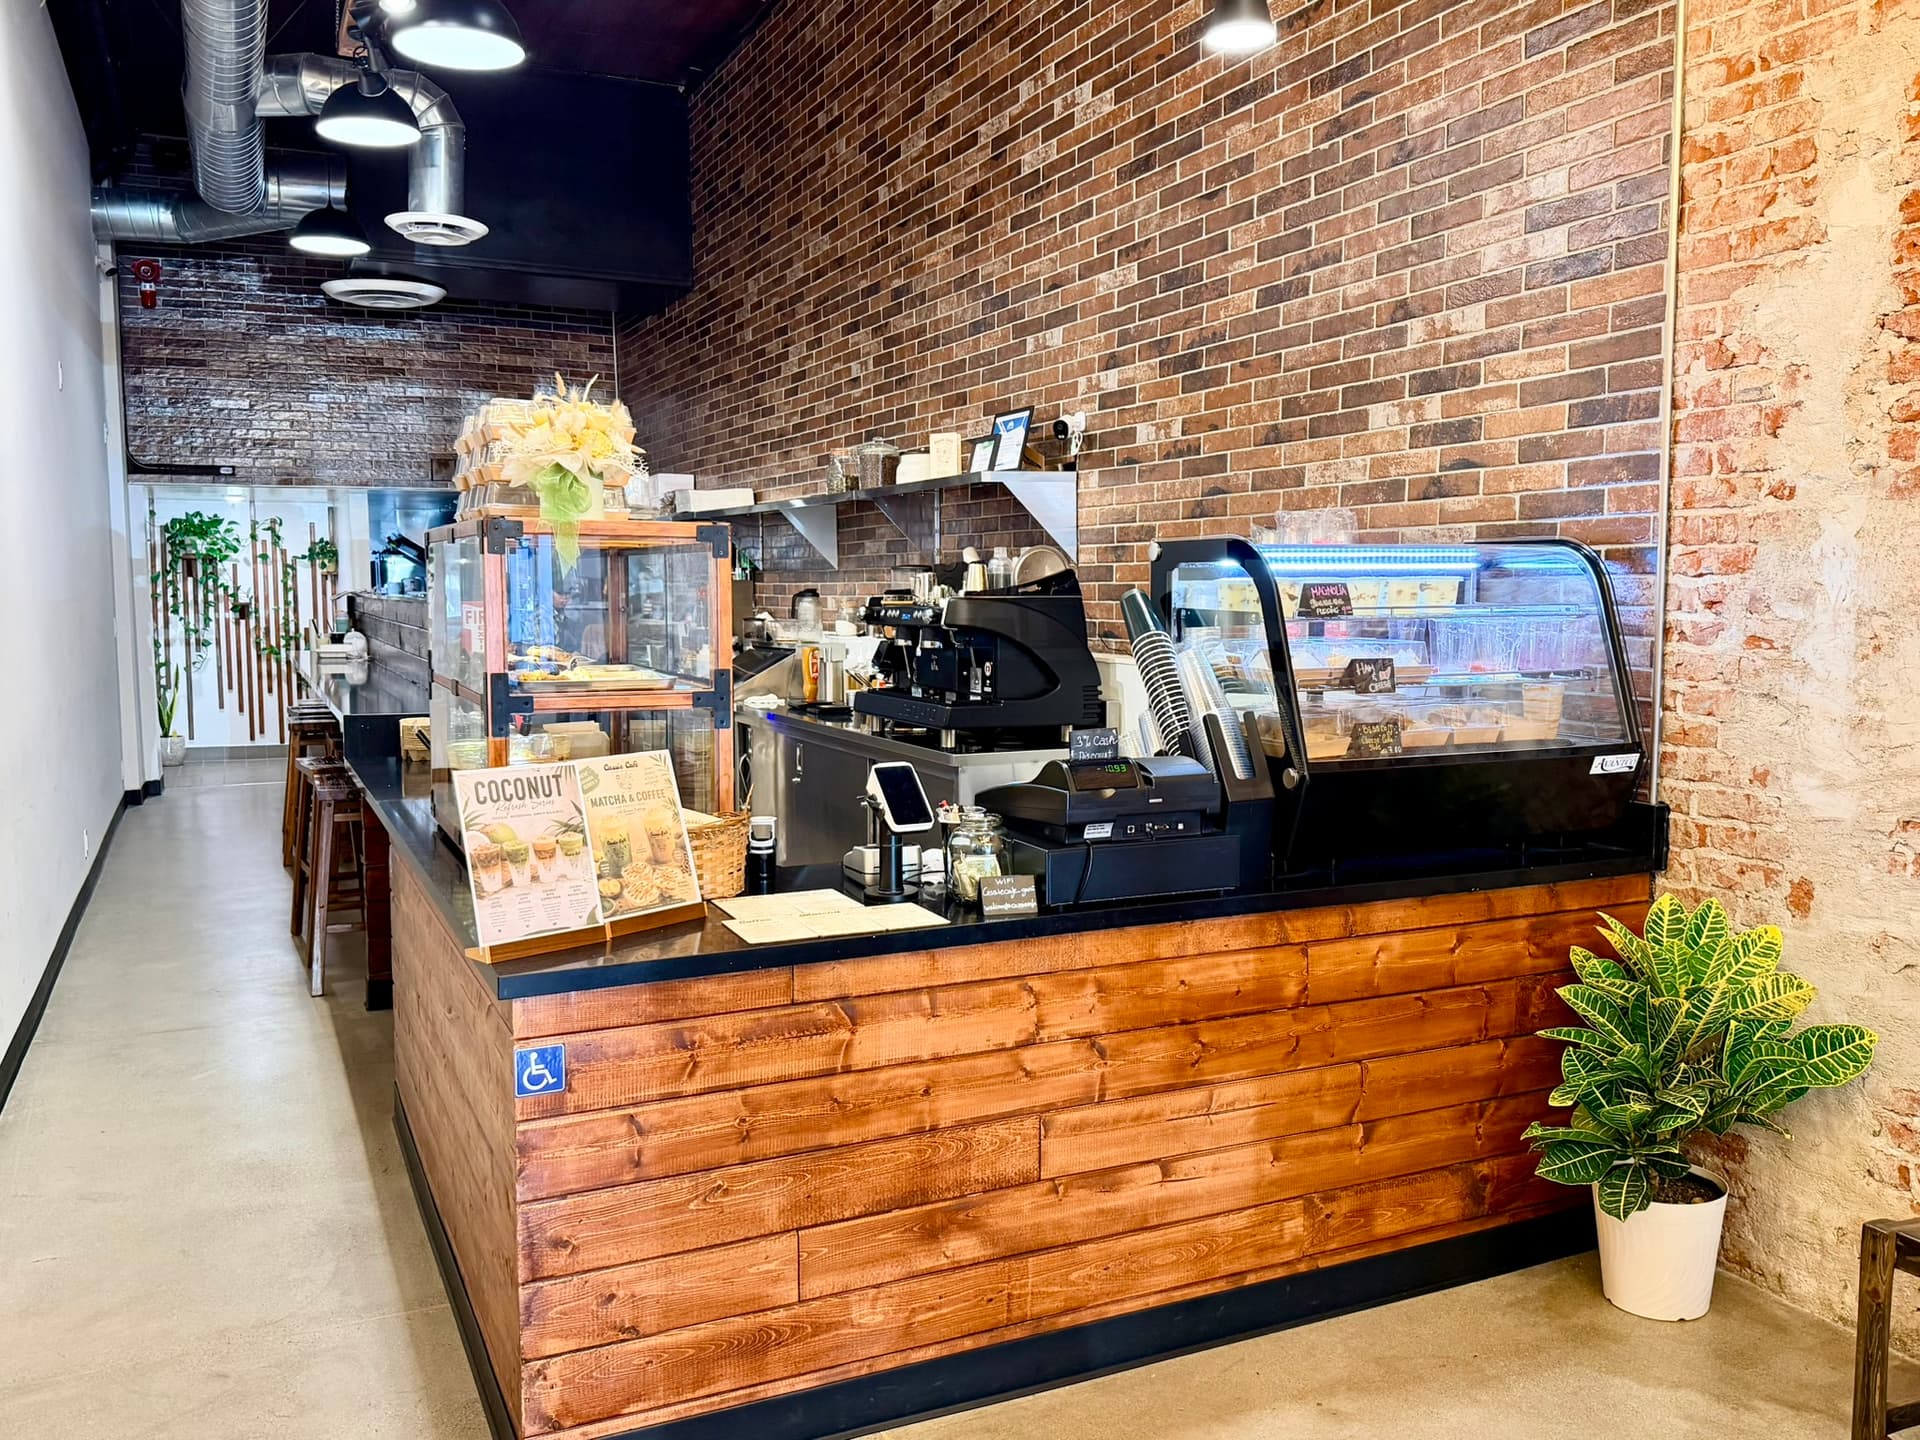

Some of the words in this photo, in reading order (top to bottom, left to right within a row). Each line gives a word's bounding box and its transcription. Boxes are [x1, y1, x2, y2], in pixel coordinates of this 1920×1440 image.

[1311, 585, 1347, 598] MAGNOLIA
[465, 610, 484, 624] FIR
[1075, 736, 1091, 747] 3%
[1093, 734, 1117, 746] Cash
[1079, 749, 1113, 760] Discount
[474, 774, 562, 805] COCONUT
[590, 794, 627, 808] MATCHA
[636, 789, 666, 802] COFFEE
